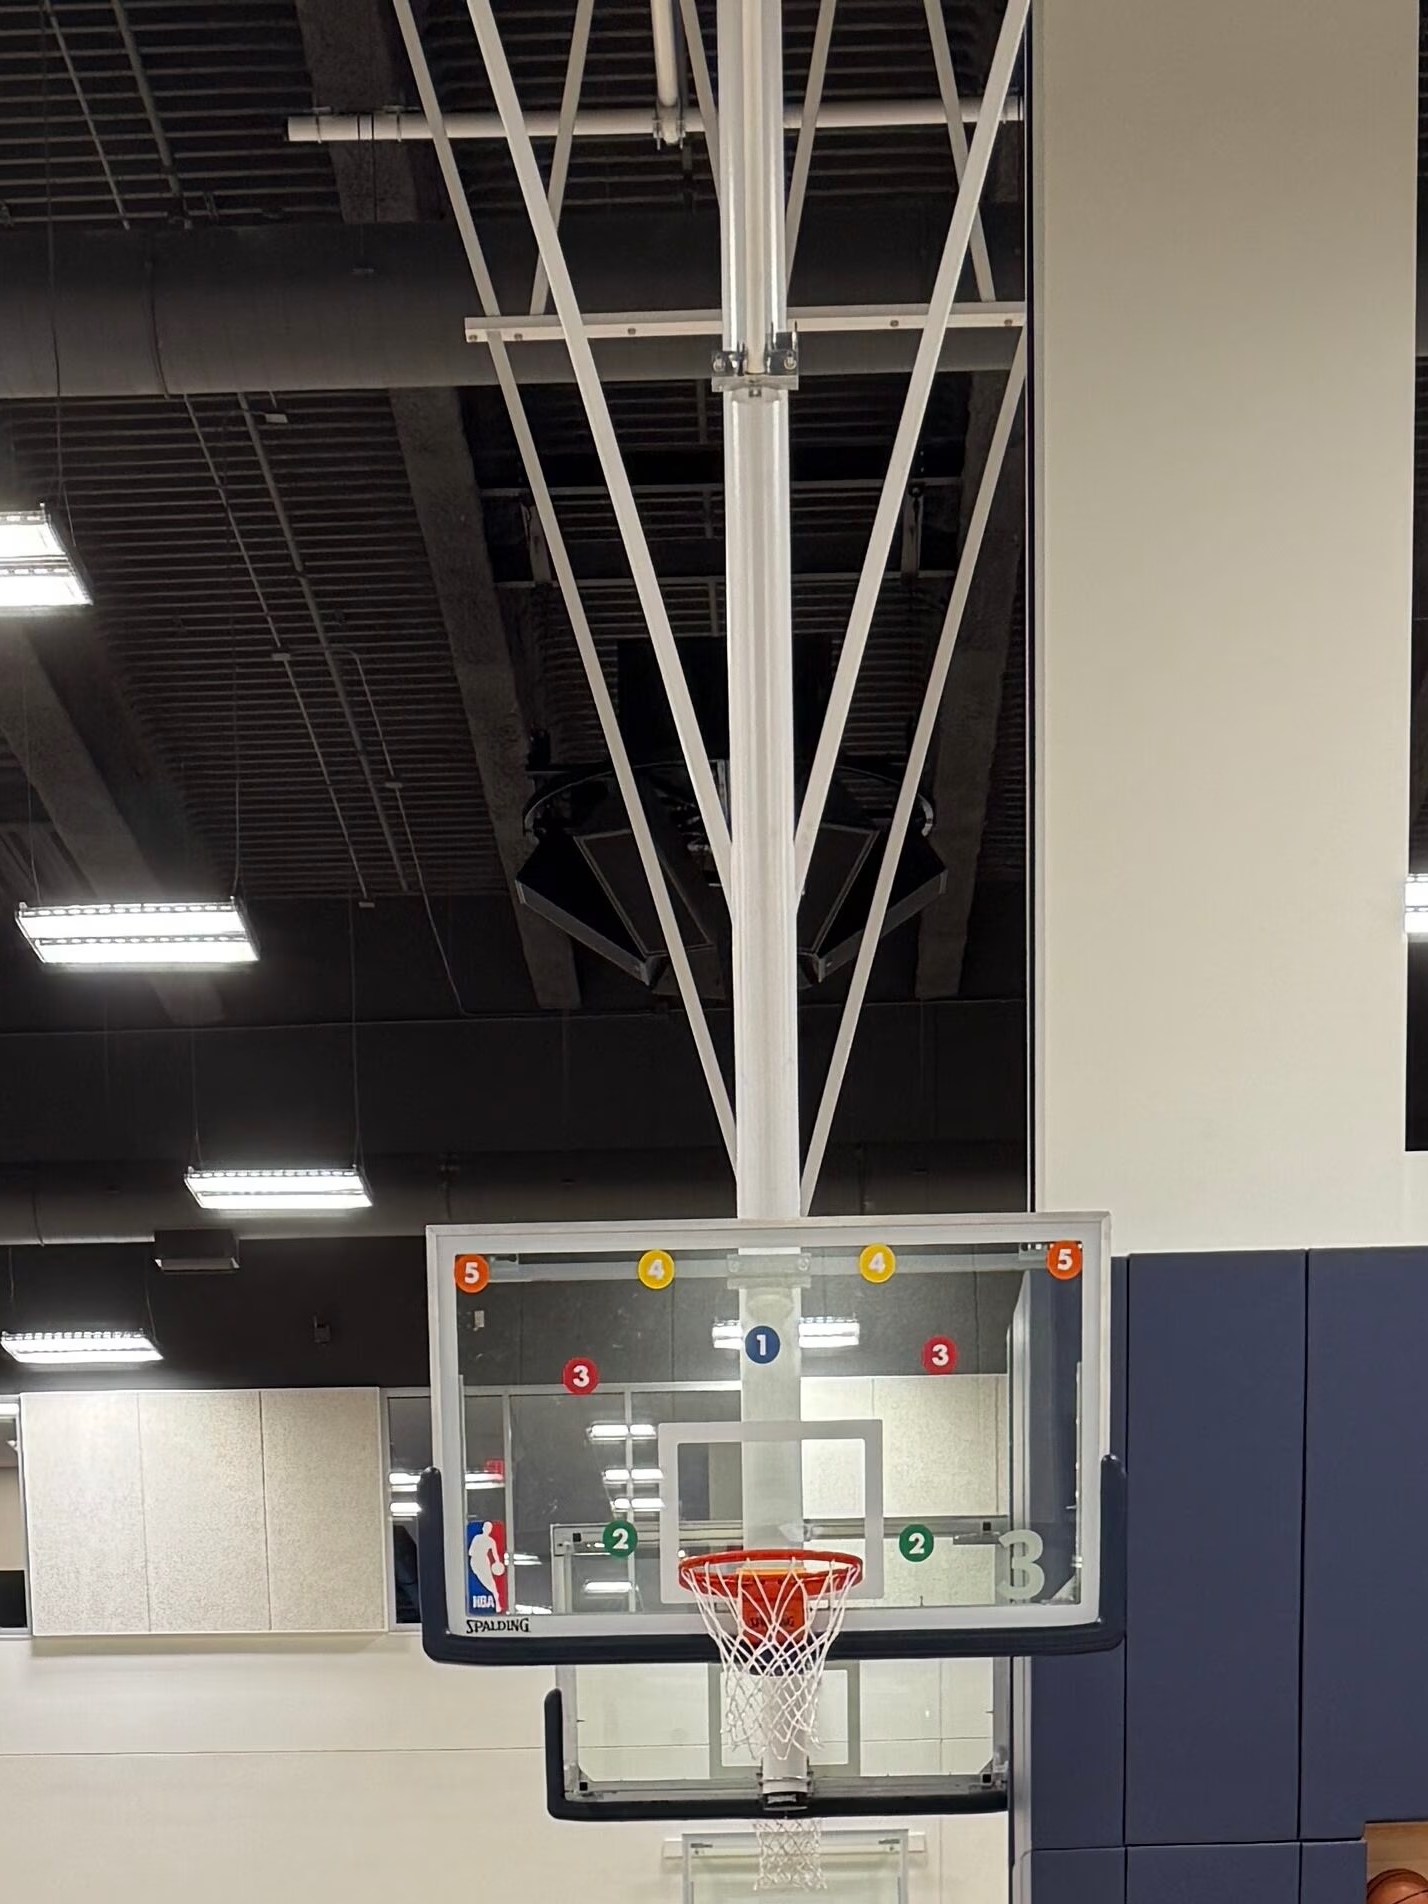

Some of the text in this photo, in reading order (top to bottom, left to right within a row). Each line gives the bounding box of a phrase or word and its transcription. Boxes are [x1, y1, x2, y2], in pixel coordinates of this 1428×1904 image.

[647, 1260, 664, 1279] 4
[869, 1254, 886, 1274] 4
[1057, 1250, 1073, 1270] 5
[464, 1262, 480, 1283] 5
[933, 1345, 949, 1364] 3
[573, 1367, 589, 1387] 3
[612, 1528, 629, 1549] 2
[908, 1533, 925, 1553] 2
[995, 1529, 1046, 1600] 3
[473, 1595, 496, 1609] NBA
[466, 1618, 531, 1634] SPALDING
